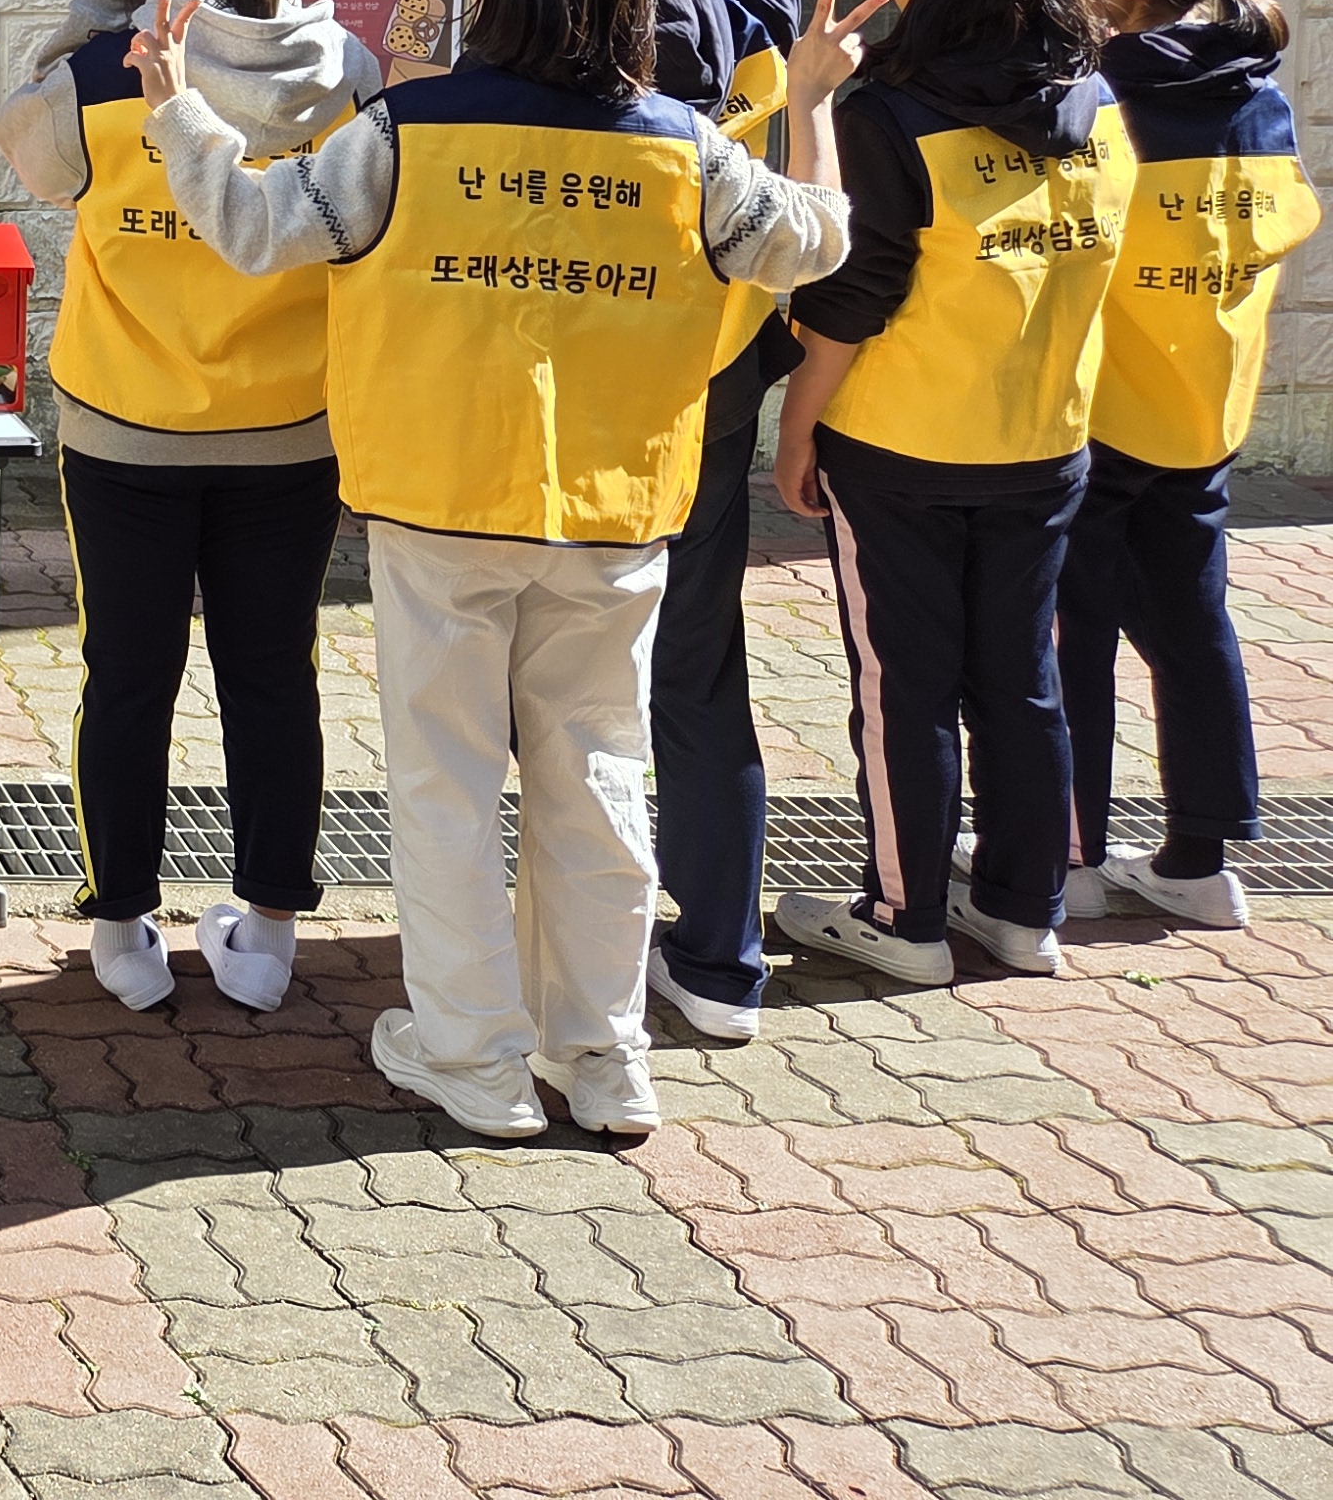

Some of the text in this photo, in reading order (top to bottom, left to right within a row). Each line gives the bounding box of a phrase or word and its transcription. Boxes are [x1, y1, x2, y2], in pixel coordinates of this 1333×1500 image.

[974, 153, 996, 184] 난
[458, 166, 641, 209] 난 너를 응원해
[1159, 192, 1184, 221] 난
[1196, 190, 1227, 220] 너를
[431, 255, 657, 300] 또래상담동아리
